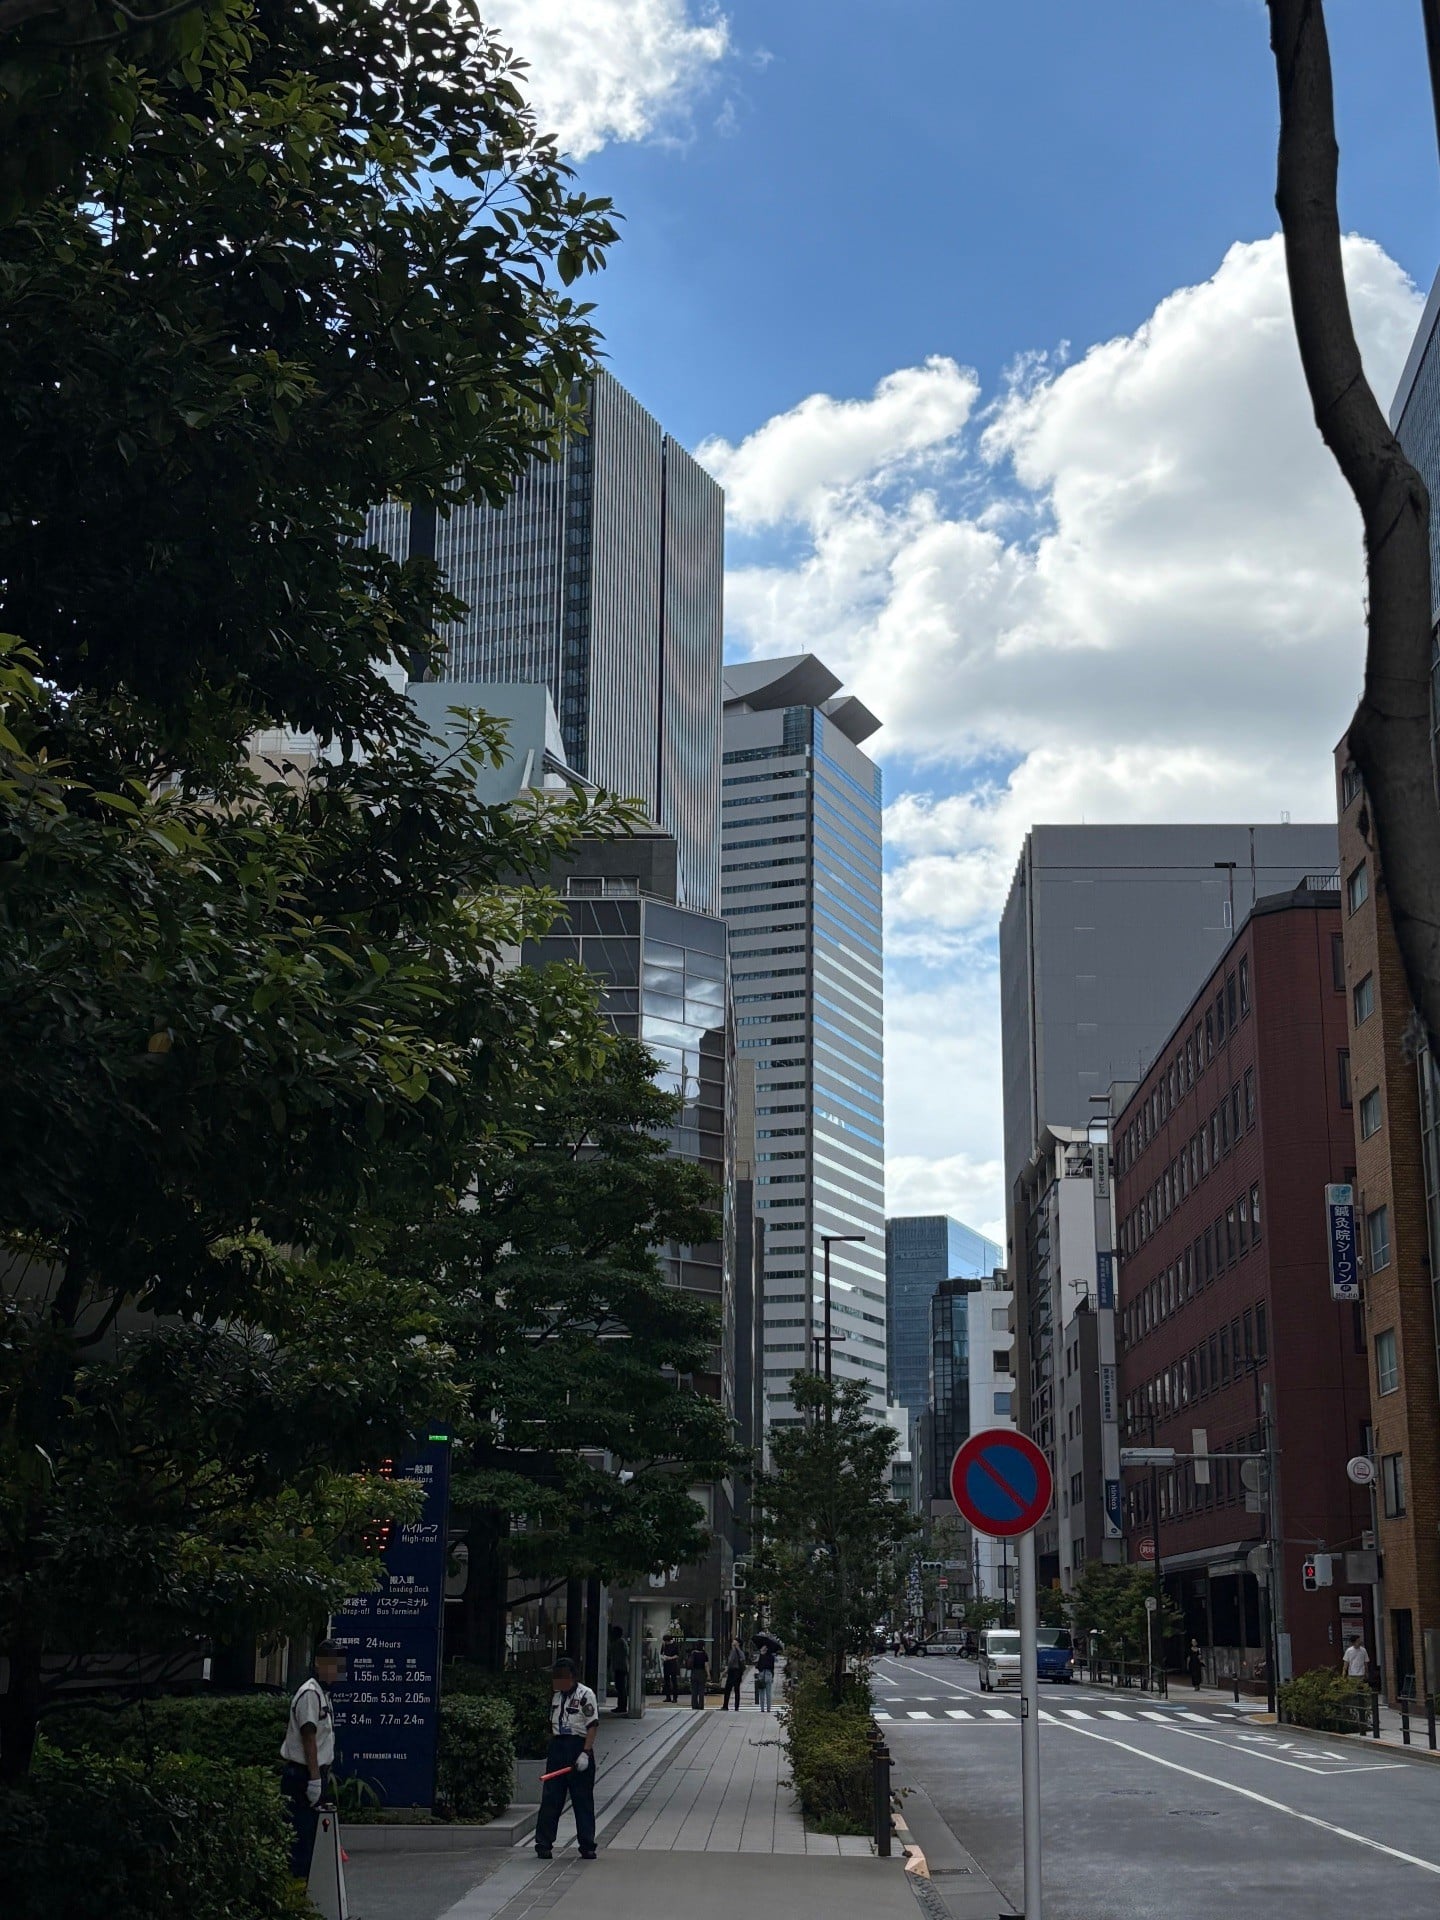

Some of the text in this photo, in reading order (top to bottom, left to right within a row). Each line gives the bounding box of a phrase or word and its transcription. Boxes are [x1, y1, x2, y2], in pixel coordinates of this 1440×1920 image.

[1334, 1205, 1352, 1284] 鍼灸院シーワン
[405, 1464, 433, 1475] 一般車
[402, 1524, 439, 1534] ハイルーフ
[402, 1535, 438, 1544] High-roof
[389, 1585, 413, 1594] Loading
[414, 1585, 430, 1593] Dock
[376, 1598, 429, 1607] バスターミナル
[342, 1607, 370, 1616] Drop-off
[391, 1607, 420, 1615] Terminal
[366, 1637, 401, 1649] 24 Hours
[353, 1671, 432, 1682] 1.55m 5.3m 2.05m
[352, 1692, 379, 1703] 2.05m
[380, 1692, 402, 1703] 5.3m
[404, 1692, 431, 1703] 2.05m
[350, 1713, 372, 1725] 3.4m
[379, 1713, 401, 1725] 7.7m
[403, 1713, 425, 1724] 2.4m
